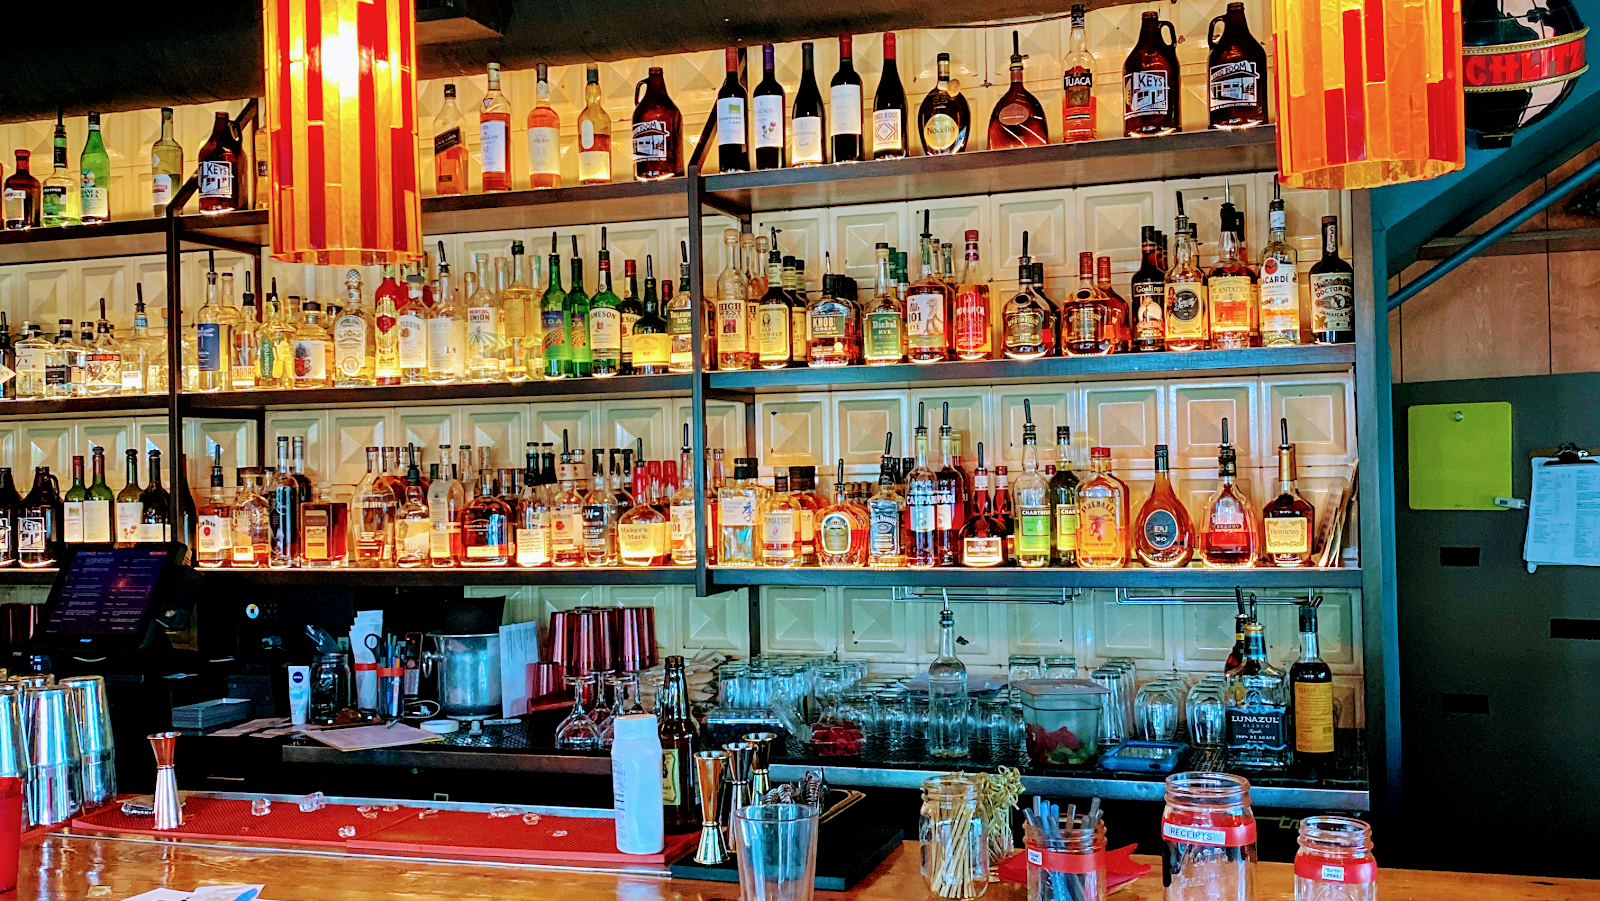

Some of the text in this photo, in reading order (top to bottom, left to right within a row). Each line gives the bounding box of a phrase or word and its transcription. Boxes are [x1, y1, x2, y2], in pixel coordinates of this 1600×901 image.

[1225, 62, 1246, 74] ROOM
[1465, 41, 1580, 85] CHLITZ
[1065, 76, 1092, 87] TUACA
[1138, 75, 1163, 87] KEYS
[927, 124, 955, 136] Nocello
[206, 163, 228, 176] KEYS
[1315, 286, 1342, 298] DOCTOR
[908, 312, 922, 323] 101
[1319, 310, 1343, 318] JAMAICA
[813, 317, 834, 328] KNOB
[263, 342, 271, 376] HORNITOS
[1081, 500, 1116, 515] FIREBALL
[22, 520, 40, 531] KEYS
[763, 516, 792, 524] PENDLETON
[1269, 526, 1300, 536] Hennessy
[1231, 715, 1279, 724] LUNAZUL
[1169, 826, 1214, 844] RECEIPTS
